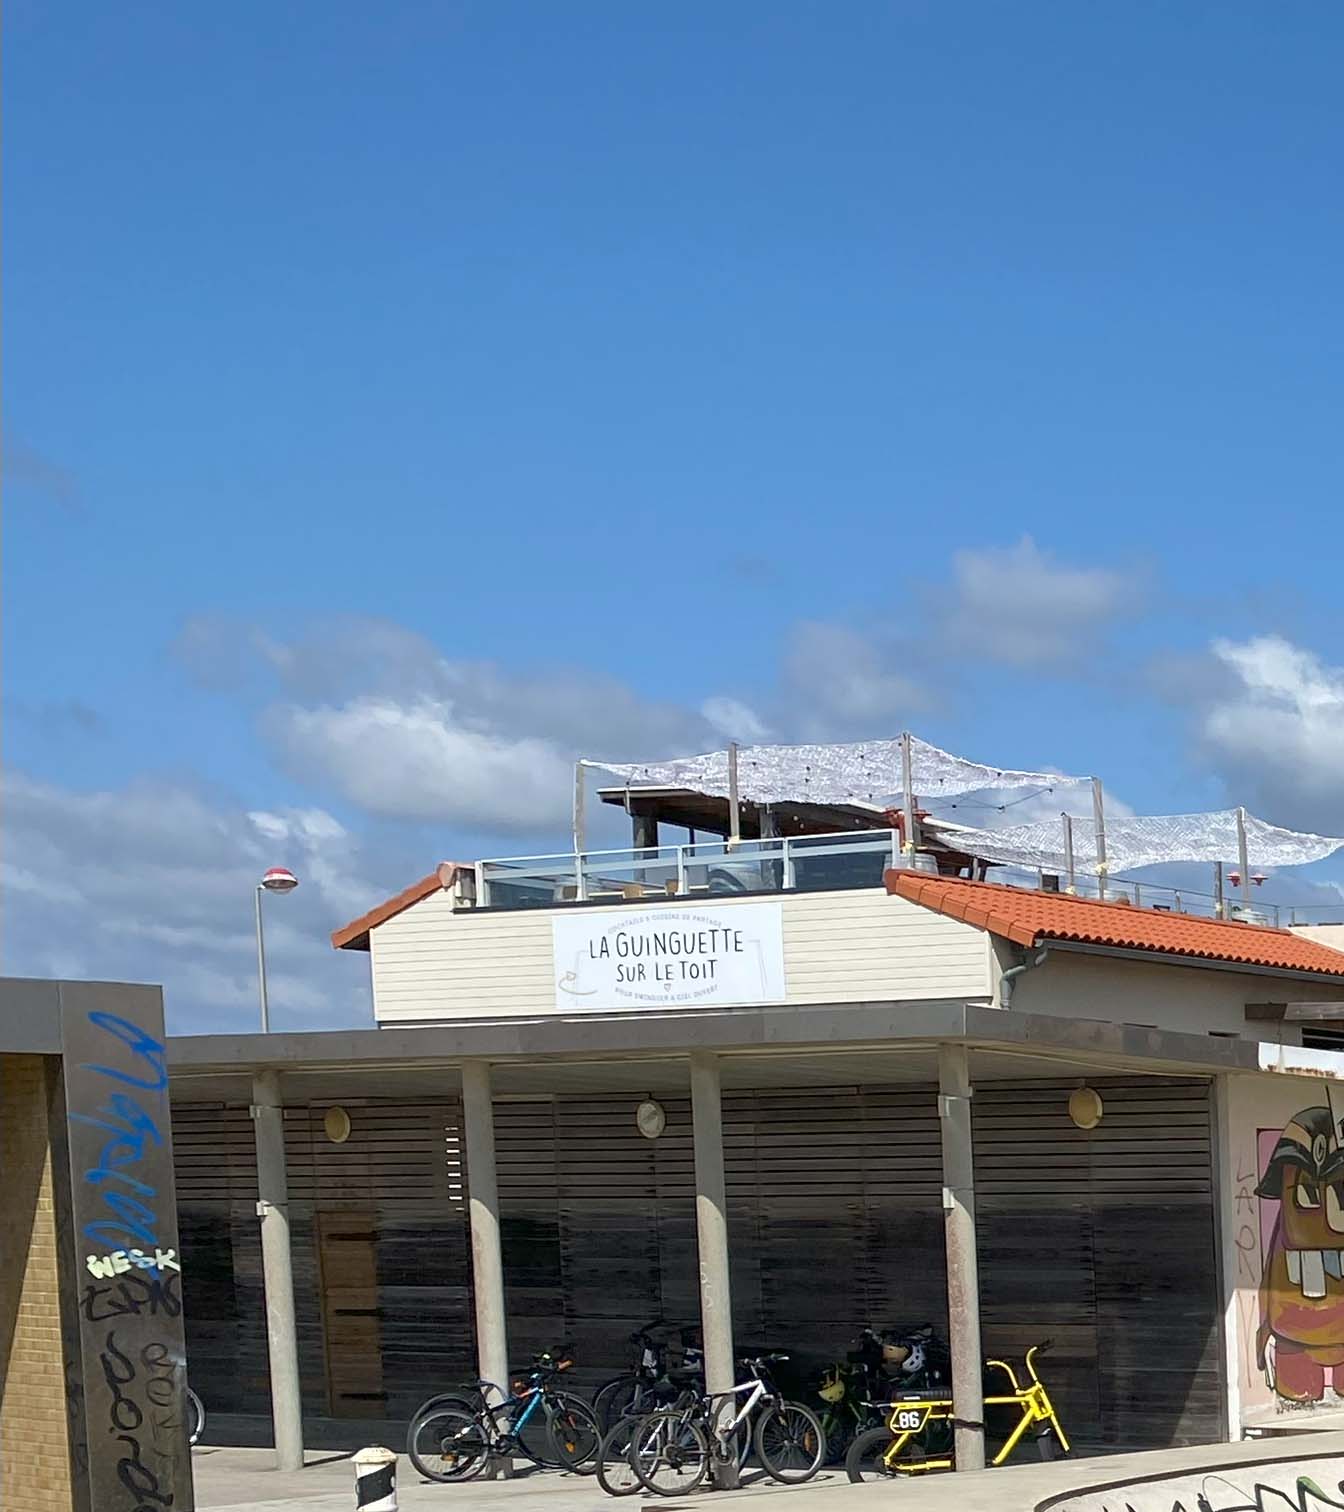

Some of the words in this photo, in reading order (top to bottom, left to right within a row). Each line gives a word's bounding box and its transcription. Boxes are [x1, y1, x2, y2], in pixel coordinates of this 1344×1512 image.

[590, 936, 610, 958] LA
[616, 928, 744, 958] GUINGUETTE
[616, 963, 646, 982] SUR
[655, 962, 674, 981] LE
[680, 959, 718, 980] TOIT
[899, 1411, 920, 1429] 86
